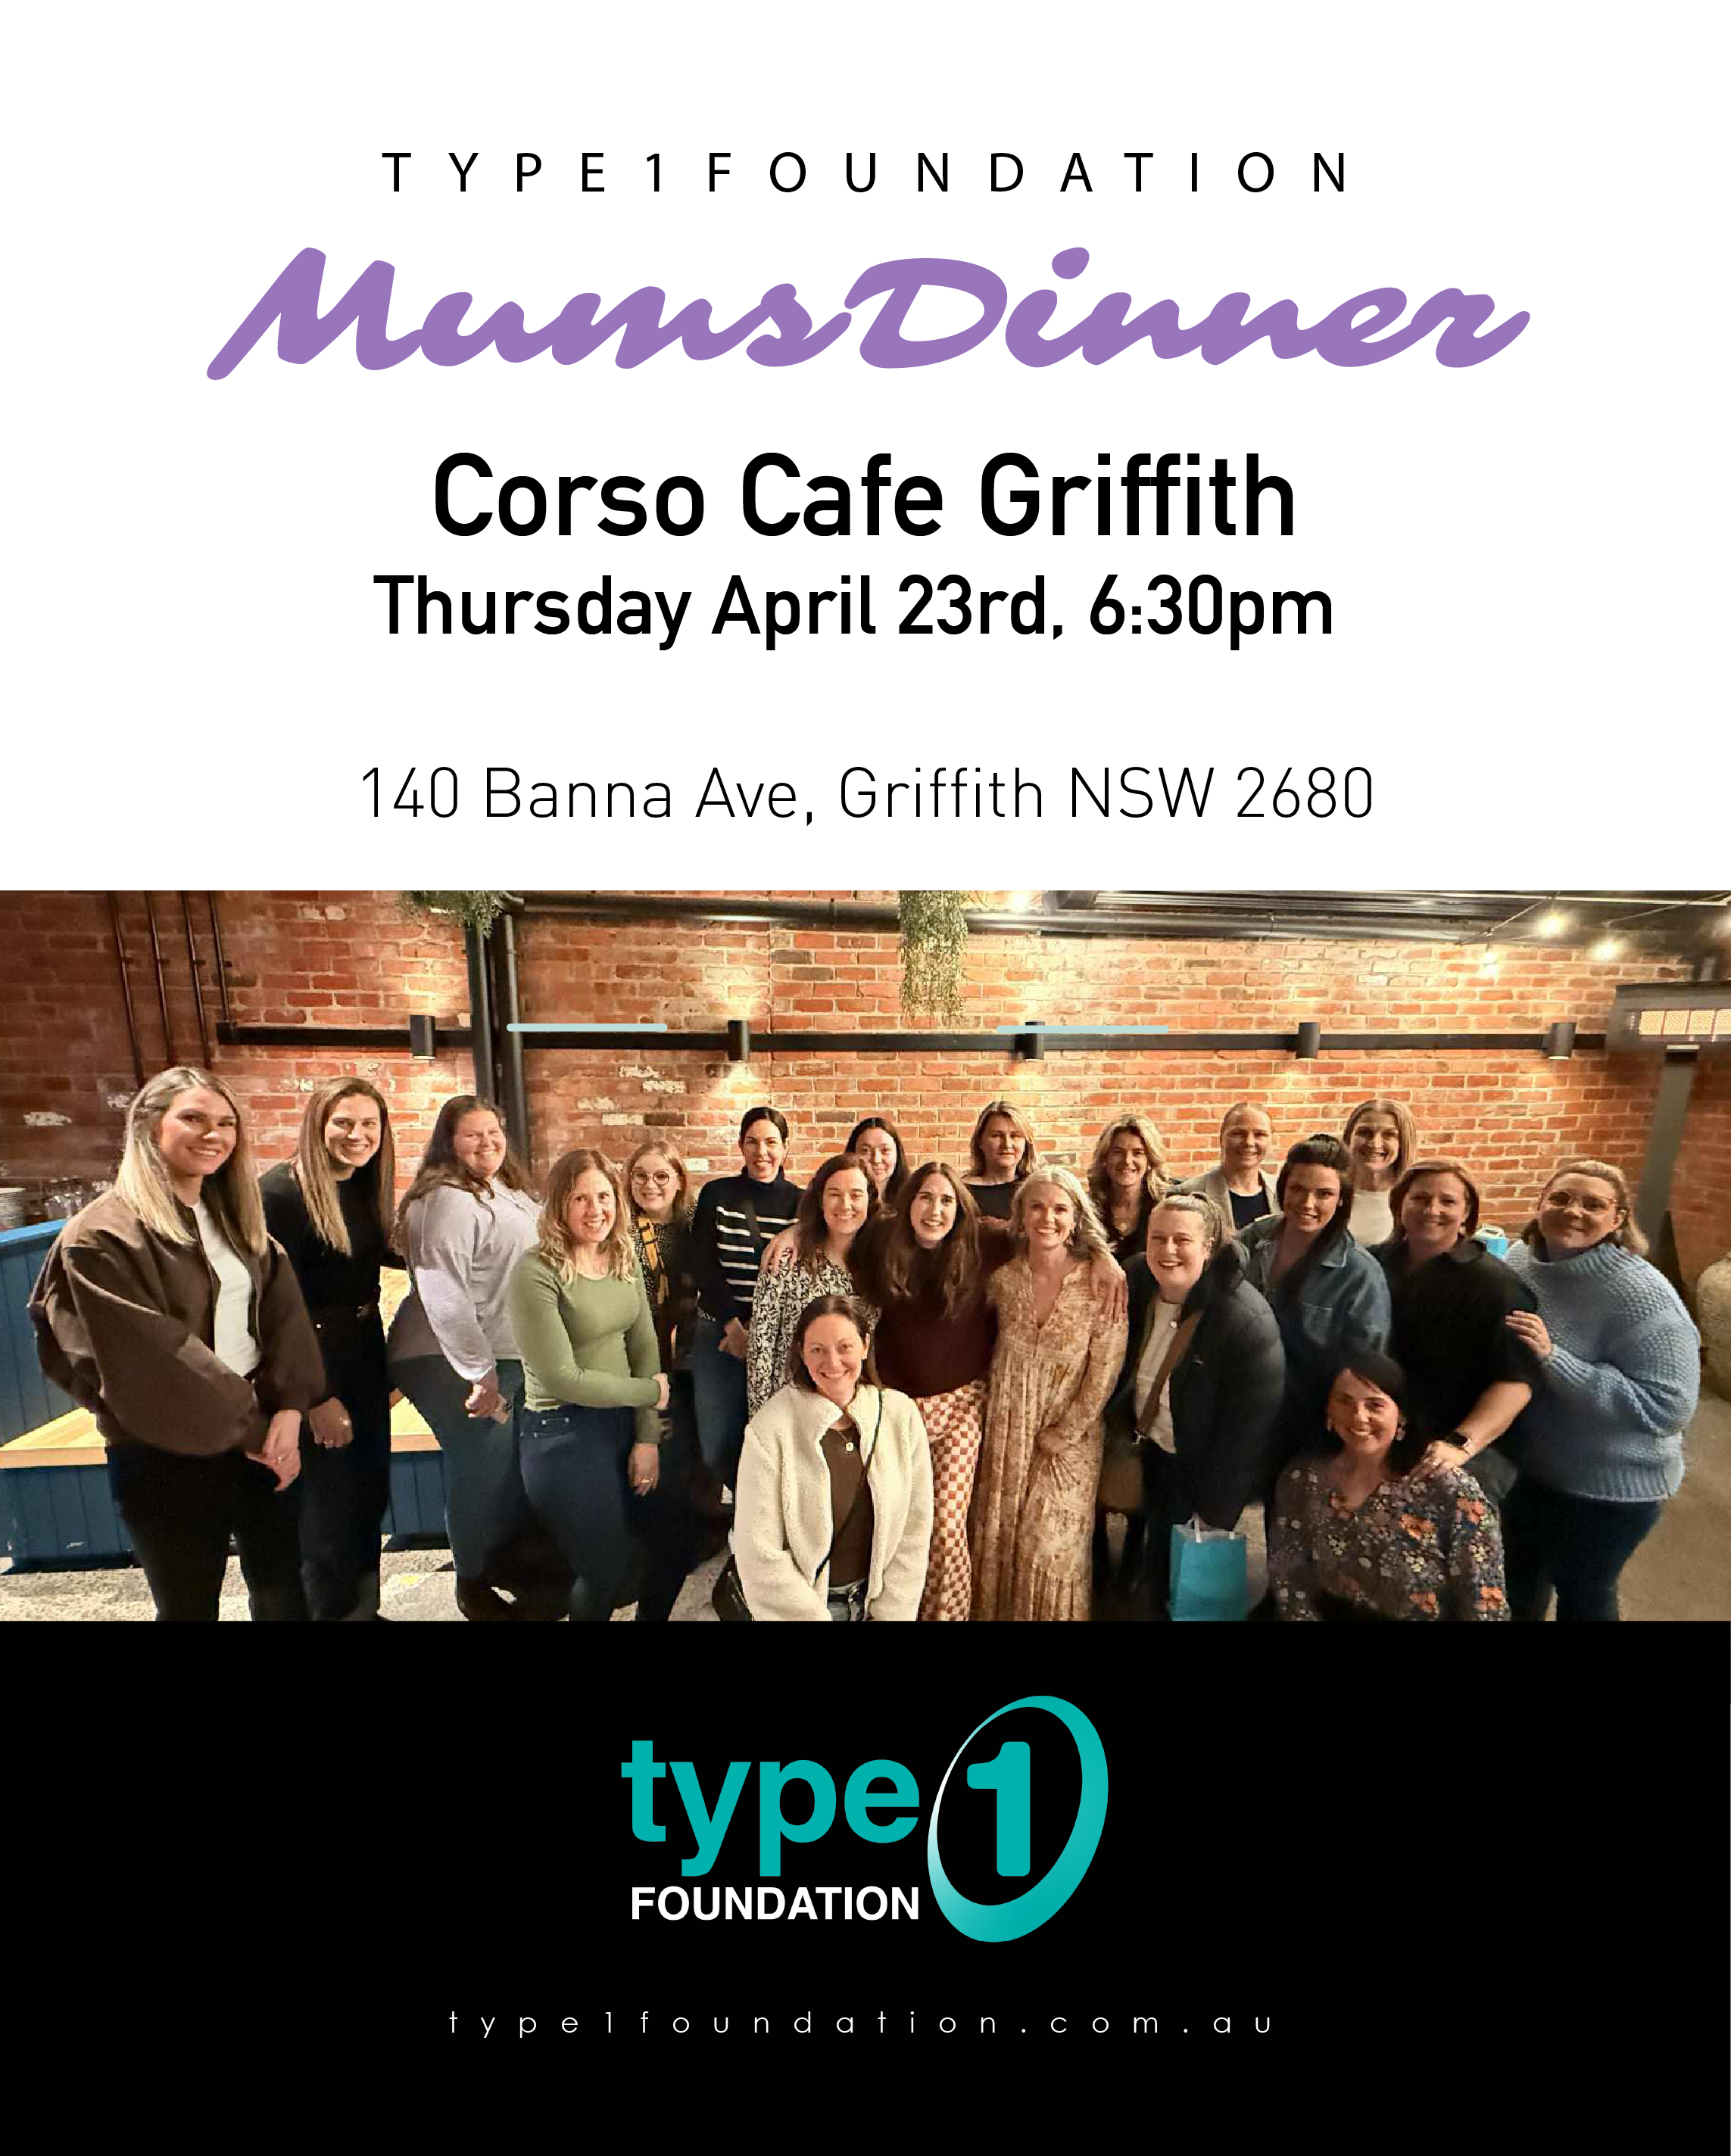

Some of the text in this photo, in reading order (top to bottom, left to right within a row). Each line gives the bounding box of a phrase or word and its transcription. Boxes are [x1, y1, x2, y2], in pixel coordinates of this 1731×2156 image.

[435, 453, 1293, 536] Corso Cafe Griffith
[373, 575, 1331, 650] Thursday April 23rd, 6:30pm
[363, 767, 1371, 826] 140 Banna Ave, Griffith NSW 2680
[632, 1886, 919, 1921] FOUNDATION
